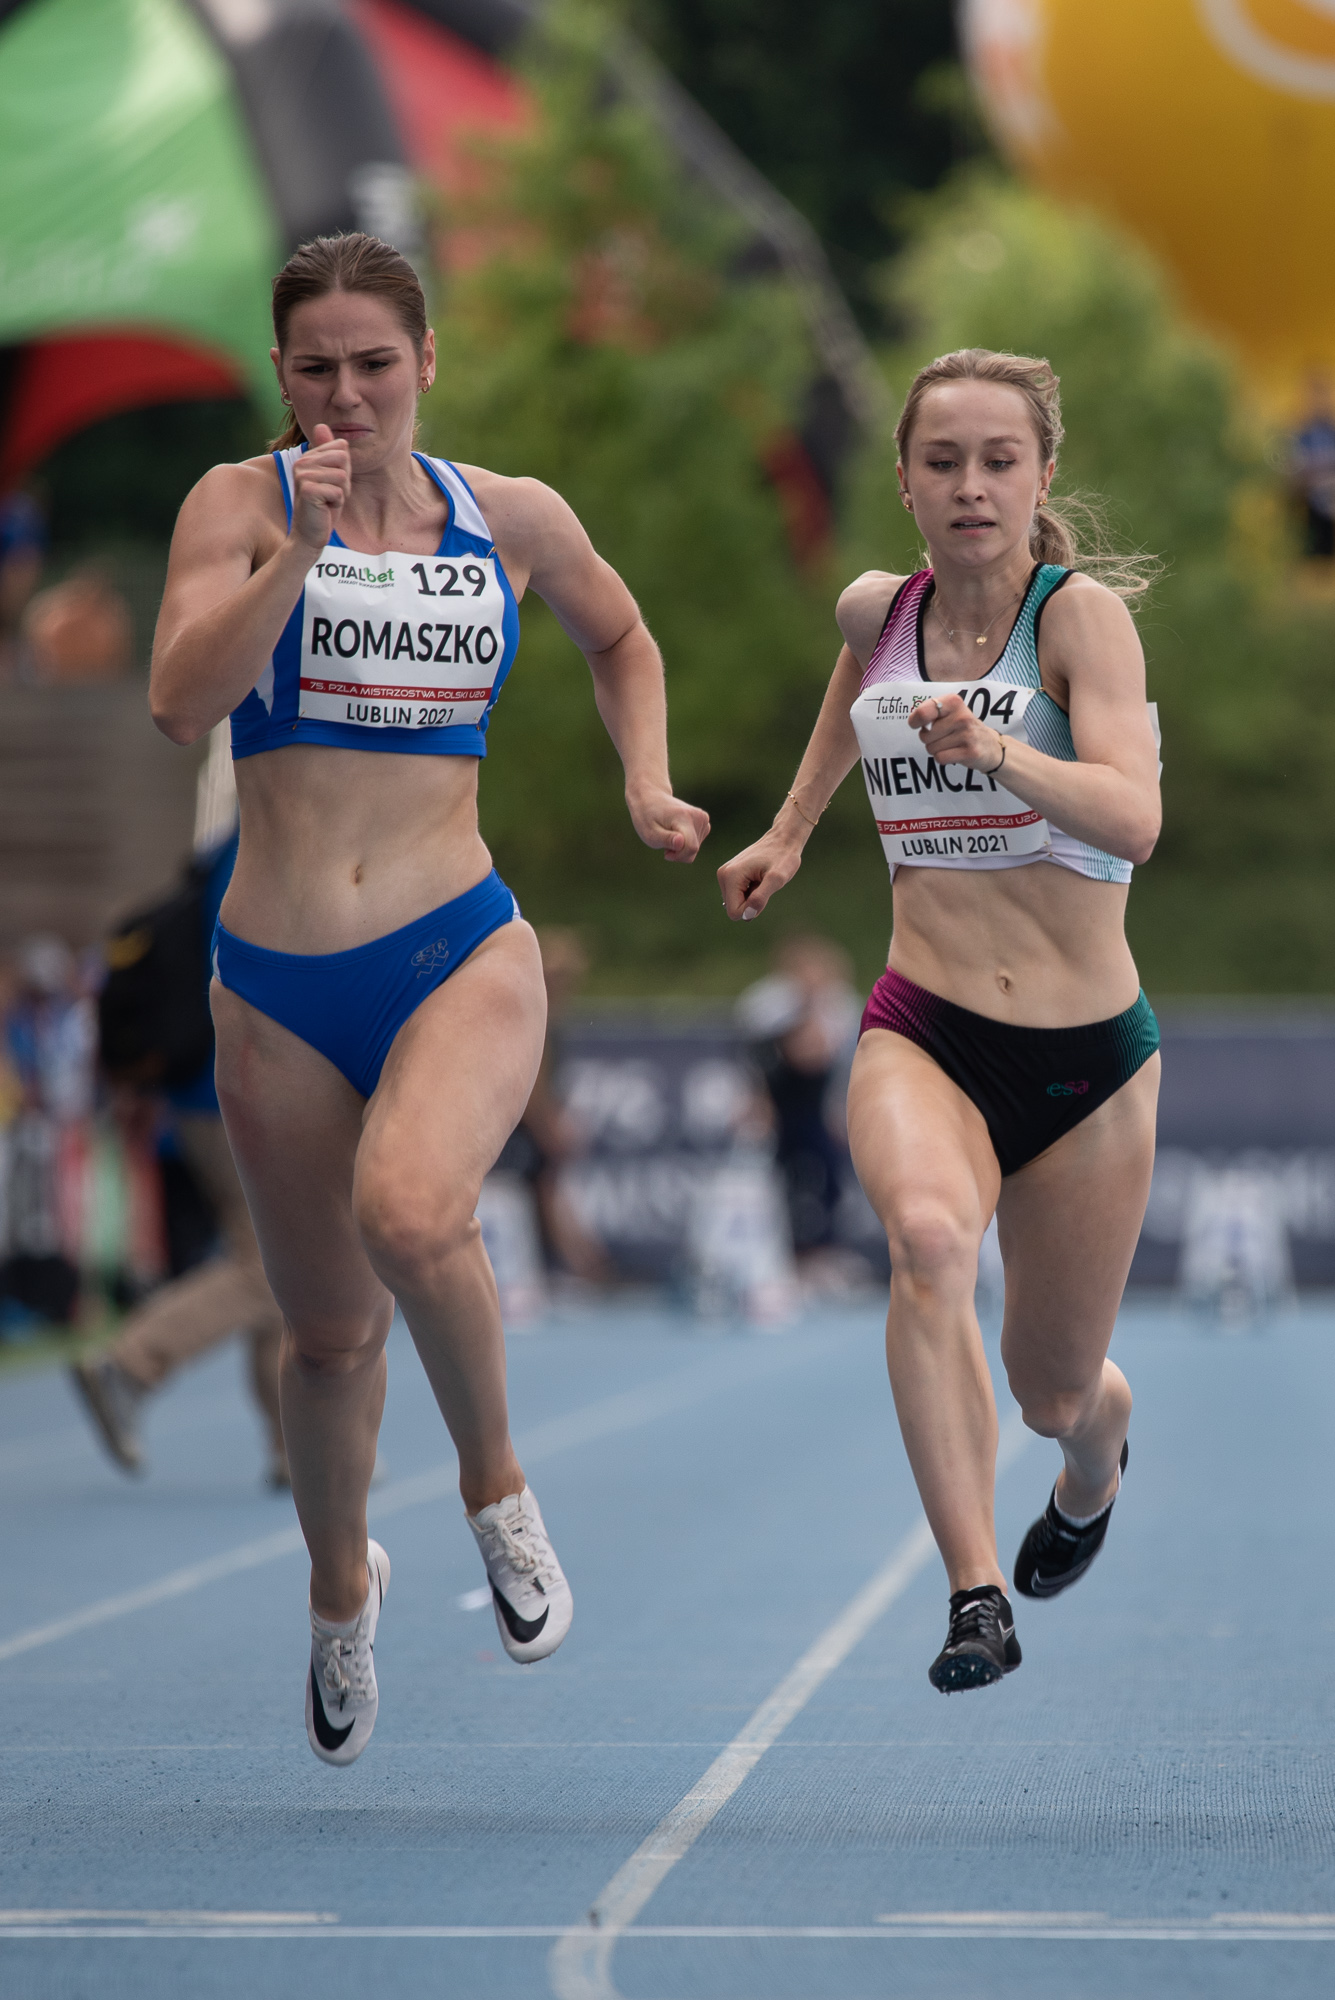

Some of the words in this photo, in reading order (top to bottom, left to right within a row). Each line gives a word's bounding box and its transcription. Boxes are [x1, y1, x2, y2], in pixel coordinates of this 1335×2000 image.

[315, 562, 395, 583] TOTALbet
[410, 562, 487, 597] 129
[311, 617, 498, 665] ROMASZKO
[309, 681, 326, 691] 75.
[328, 683, 357, 694] PZLA
[360, 687, 436, 699] MISTRZOSTWA
[437, 690, 468, 699] POLSKI
[469, 690, 486, 699] U20
[346, 702, 412, 724] LUBLIN
[416, 708, 455, 725] 2021
[884, 824, 908, 832] PZLA
[909, 819, 978, 830] MISTRZOSTWA
[981, 817, 1014, 827] POLSKI
[1015, 812, 1039, 825] U20
[901, 836, 963, 857] LUBLIN
[967, 835, 1009, 854] 2021
